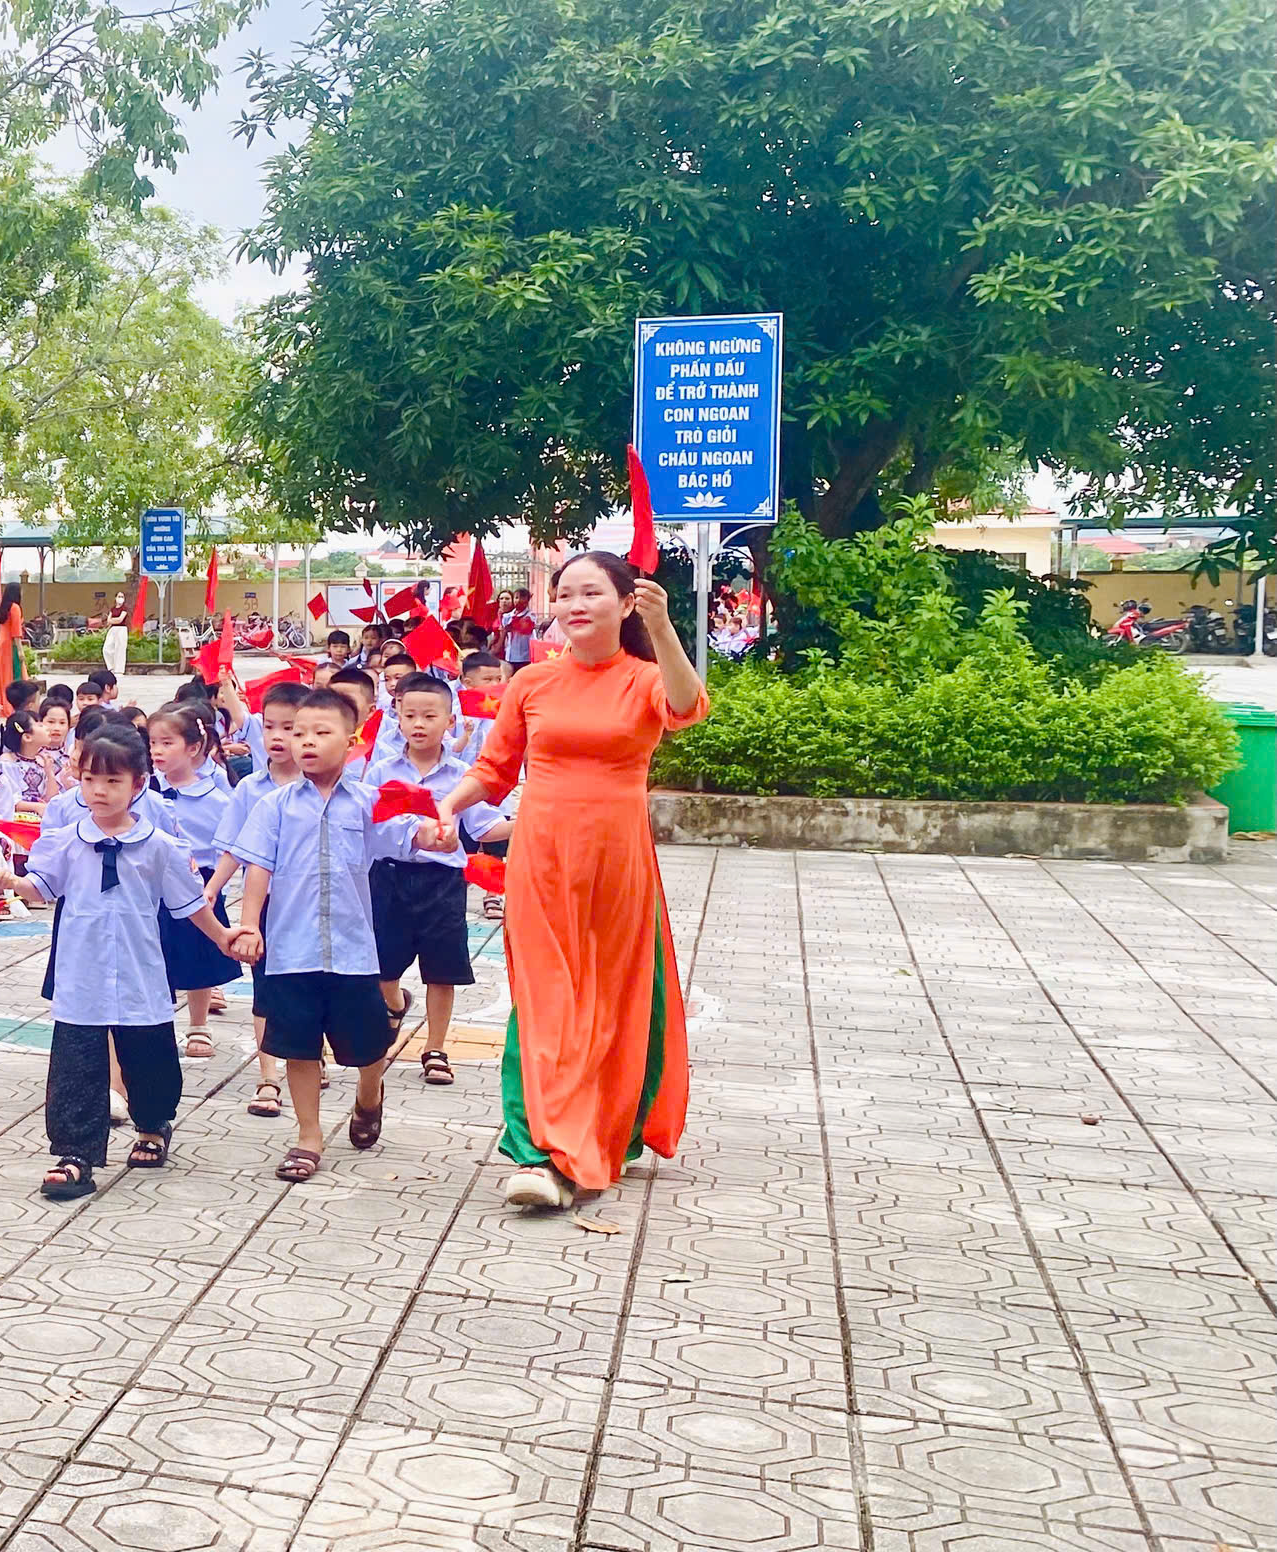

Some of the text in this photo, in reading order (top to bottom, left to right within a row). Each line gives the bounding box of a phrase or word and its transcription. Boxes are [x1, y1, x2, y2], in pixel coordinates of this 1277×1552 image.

[655, 337, 761, 356] KHÔNG NGỪNG
[670, 357, 745, 378] PHẤN ĐẤU
[656, 381, 759, 400] ĐỂ TRỞ THÀNH
[664, 406, 749, 422] CON NGOAN
[675, 425, 736, 444] TRÒ GIỎI
[659, 450, 753, 466] CHÁU NGOAN
[678, 472, 707, 488] BÁC
